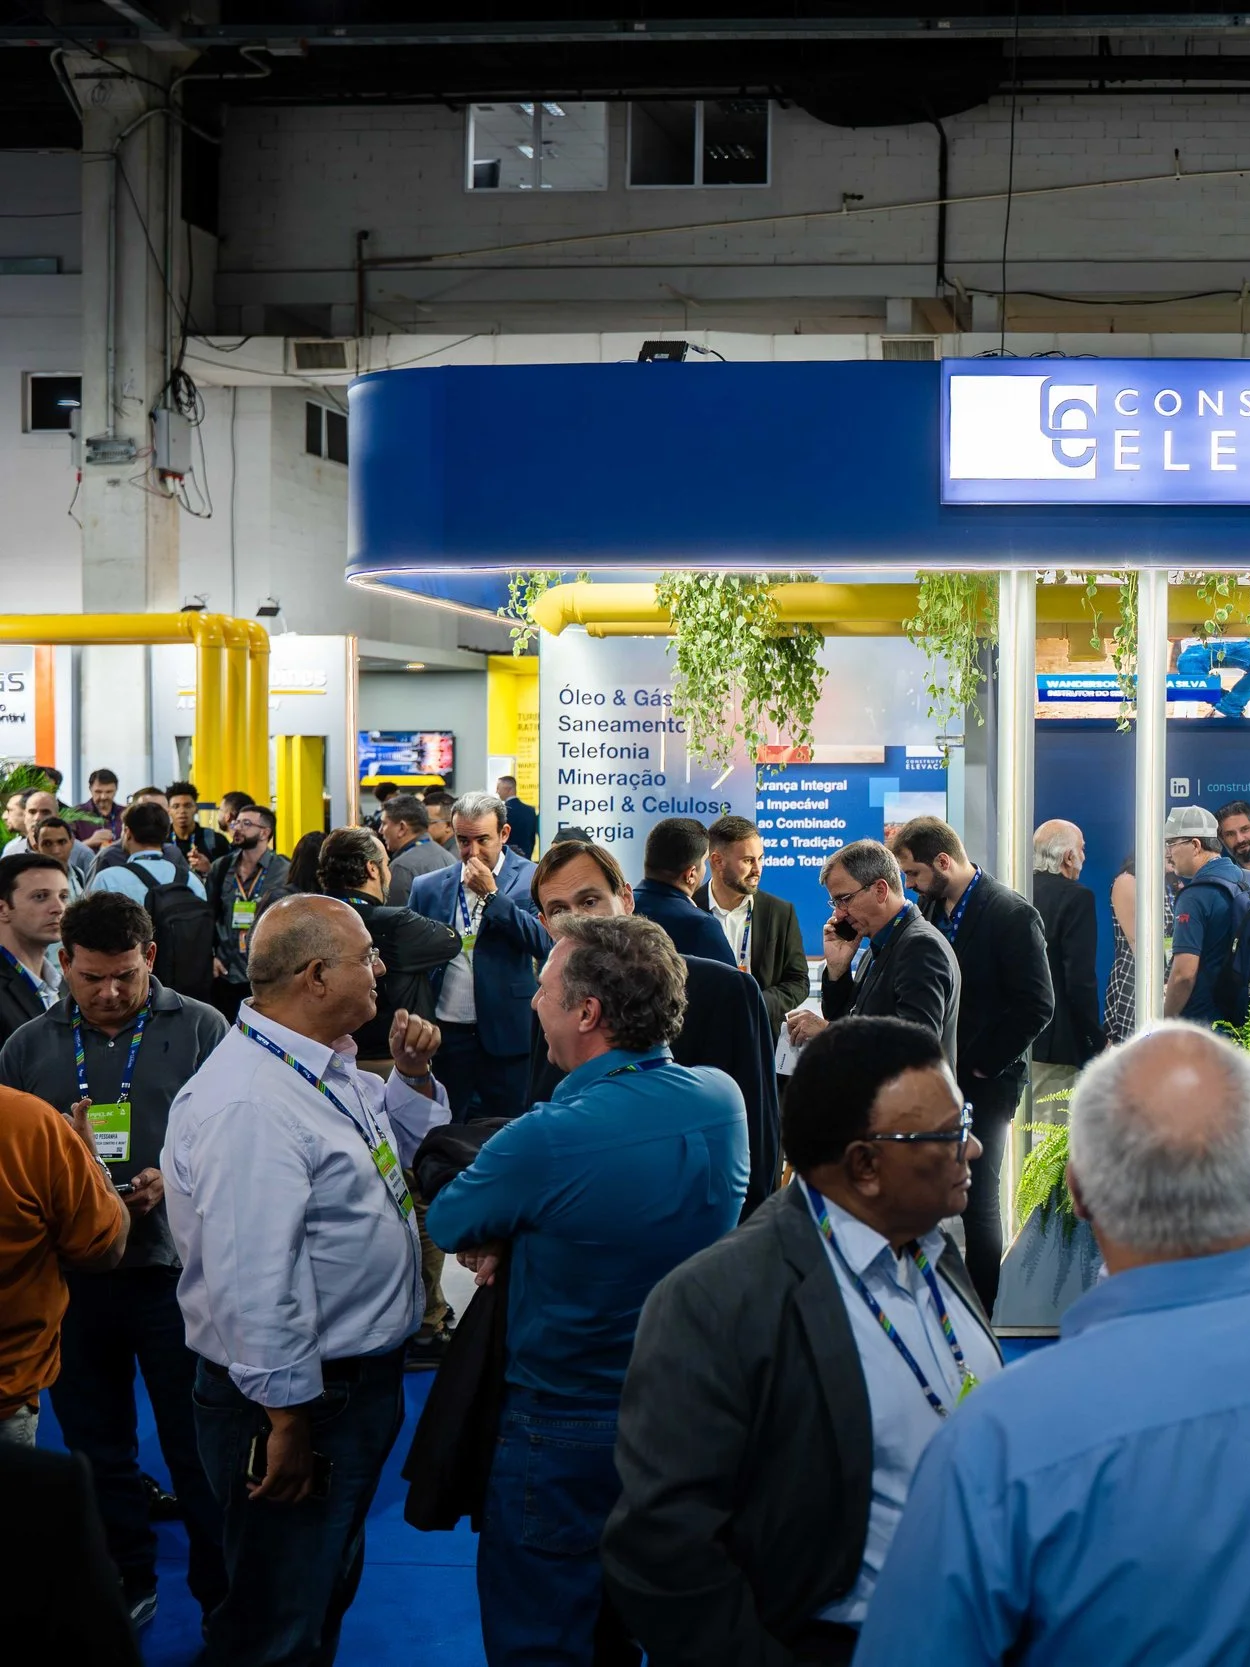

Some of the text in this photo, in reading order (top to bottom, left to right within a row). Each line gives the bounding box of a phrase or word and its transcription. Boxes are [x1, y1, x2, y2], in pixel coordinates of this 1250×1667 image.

[1175, 680, 1207, 688] SILVA
[559, 684, 673, 706] Óleo & Gás
[558, 715, 687, 733] Saneamento
[558, 742, 649, 760] Telefonia
[558, 768, 666, 790] Mineração
[801, 780, 847, 793] Integral
[558, 795, 732, 815] Papel & Celulose
[767, 799, 828, 811] Impecável
[758, 817, 846, 829] ao Combinado
[558, 821, 634, 842] Eergia
[780, 839, 788, 848] e
[791, 836, 843, 850] Tradição
[798, 855, 826, 866] Total
